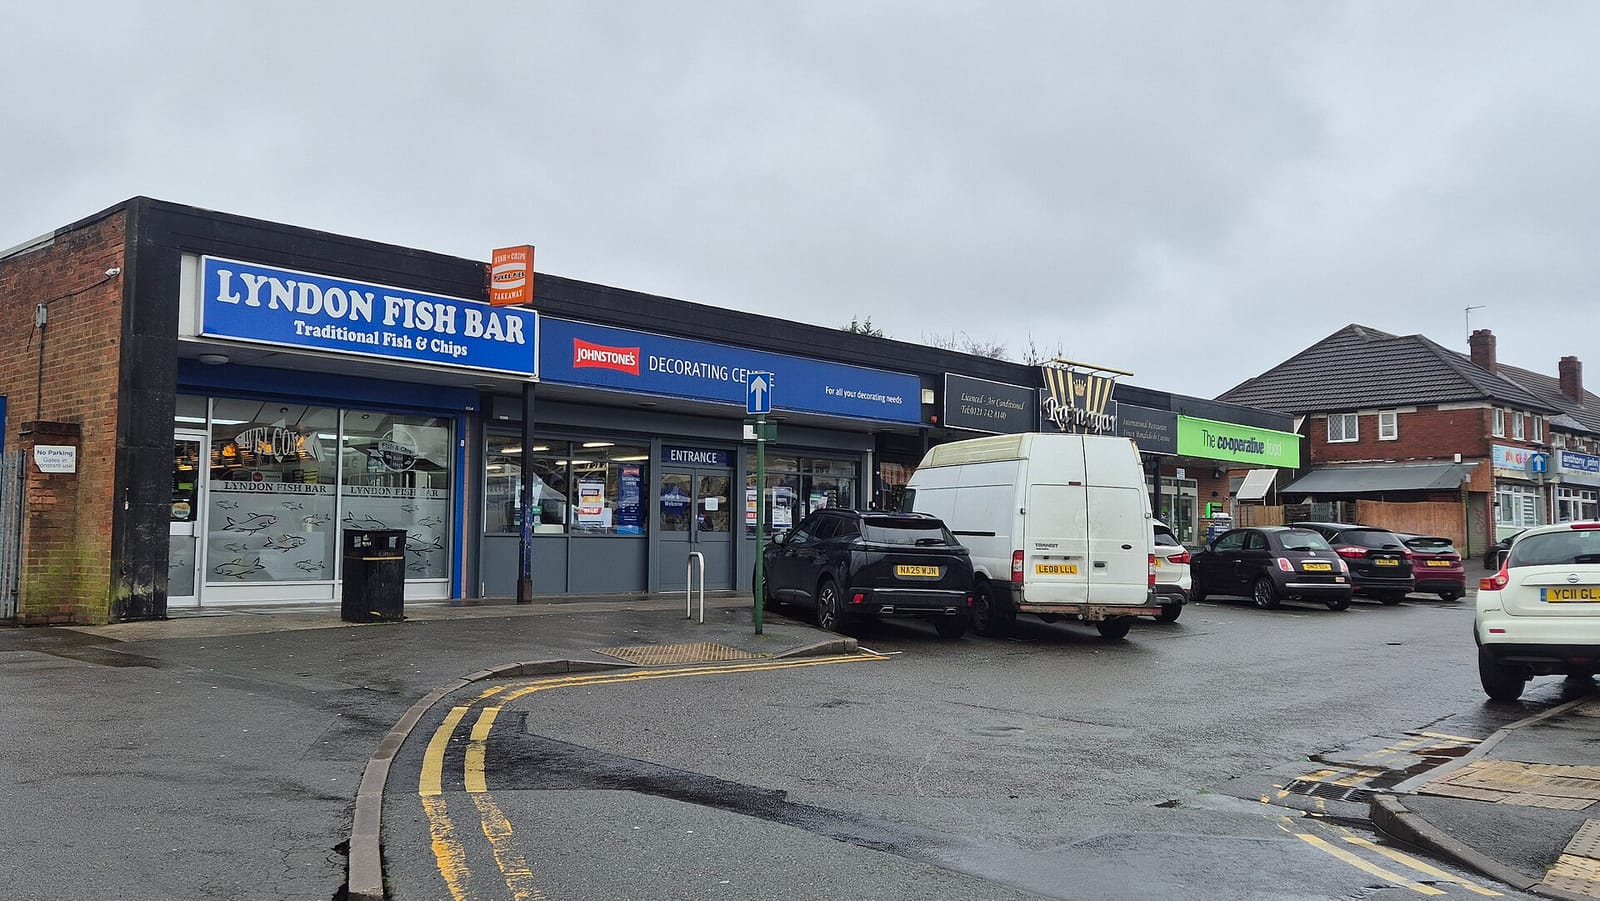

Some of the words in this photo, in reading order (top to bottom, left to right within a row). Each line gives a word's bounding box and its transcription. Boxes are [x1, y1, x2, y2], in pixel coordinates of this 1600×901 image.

[511, 252, 526, 261] CHIPS
[494, 290, 523, 300] TAKEAWAY
[216, 269, 375, 323] LYNDON
[382, 295, 457, 340] FISH
[464, 308, 526, 345] BAR
[293, 320, 380, 346] Traditional
[382, 332, 413, 355] Fish
[415, 336, 427, 355] &
[430, 343, 468, 363] Chips
[576, 347, 635, 366] JOHNSTONE'S
[649, 355, 728, 381] DECORATING
[732, 366, 775, 387] CEE
[825, 386, 834, 395] For
[844, 390, 856, 398] your
[857, 391, 886, 403] decorating
[886, 396, 903, 404] needs
[1202, 429, 1216, 449] The
[48, 449, 73, 458] Parking
[670, 449, 718, 464] ENTRANCE
[224, 481, 273, 491] LYNDON
[276, 483, 302, 492] FISH
[305, 484, 328, 493] BAR
[350, 486, 392, 495] LYNDON
[395, 488, 416, 496] FISH
[1553, 589, 1577, 600] YC11
[1580, 589, 1600, 600] GL
